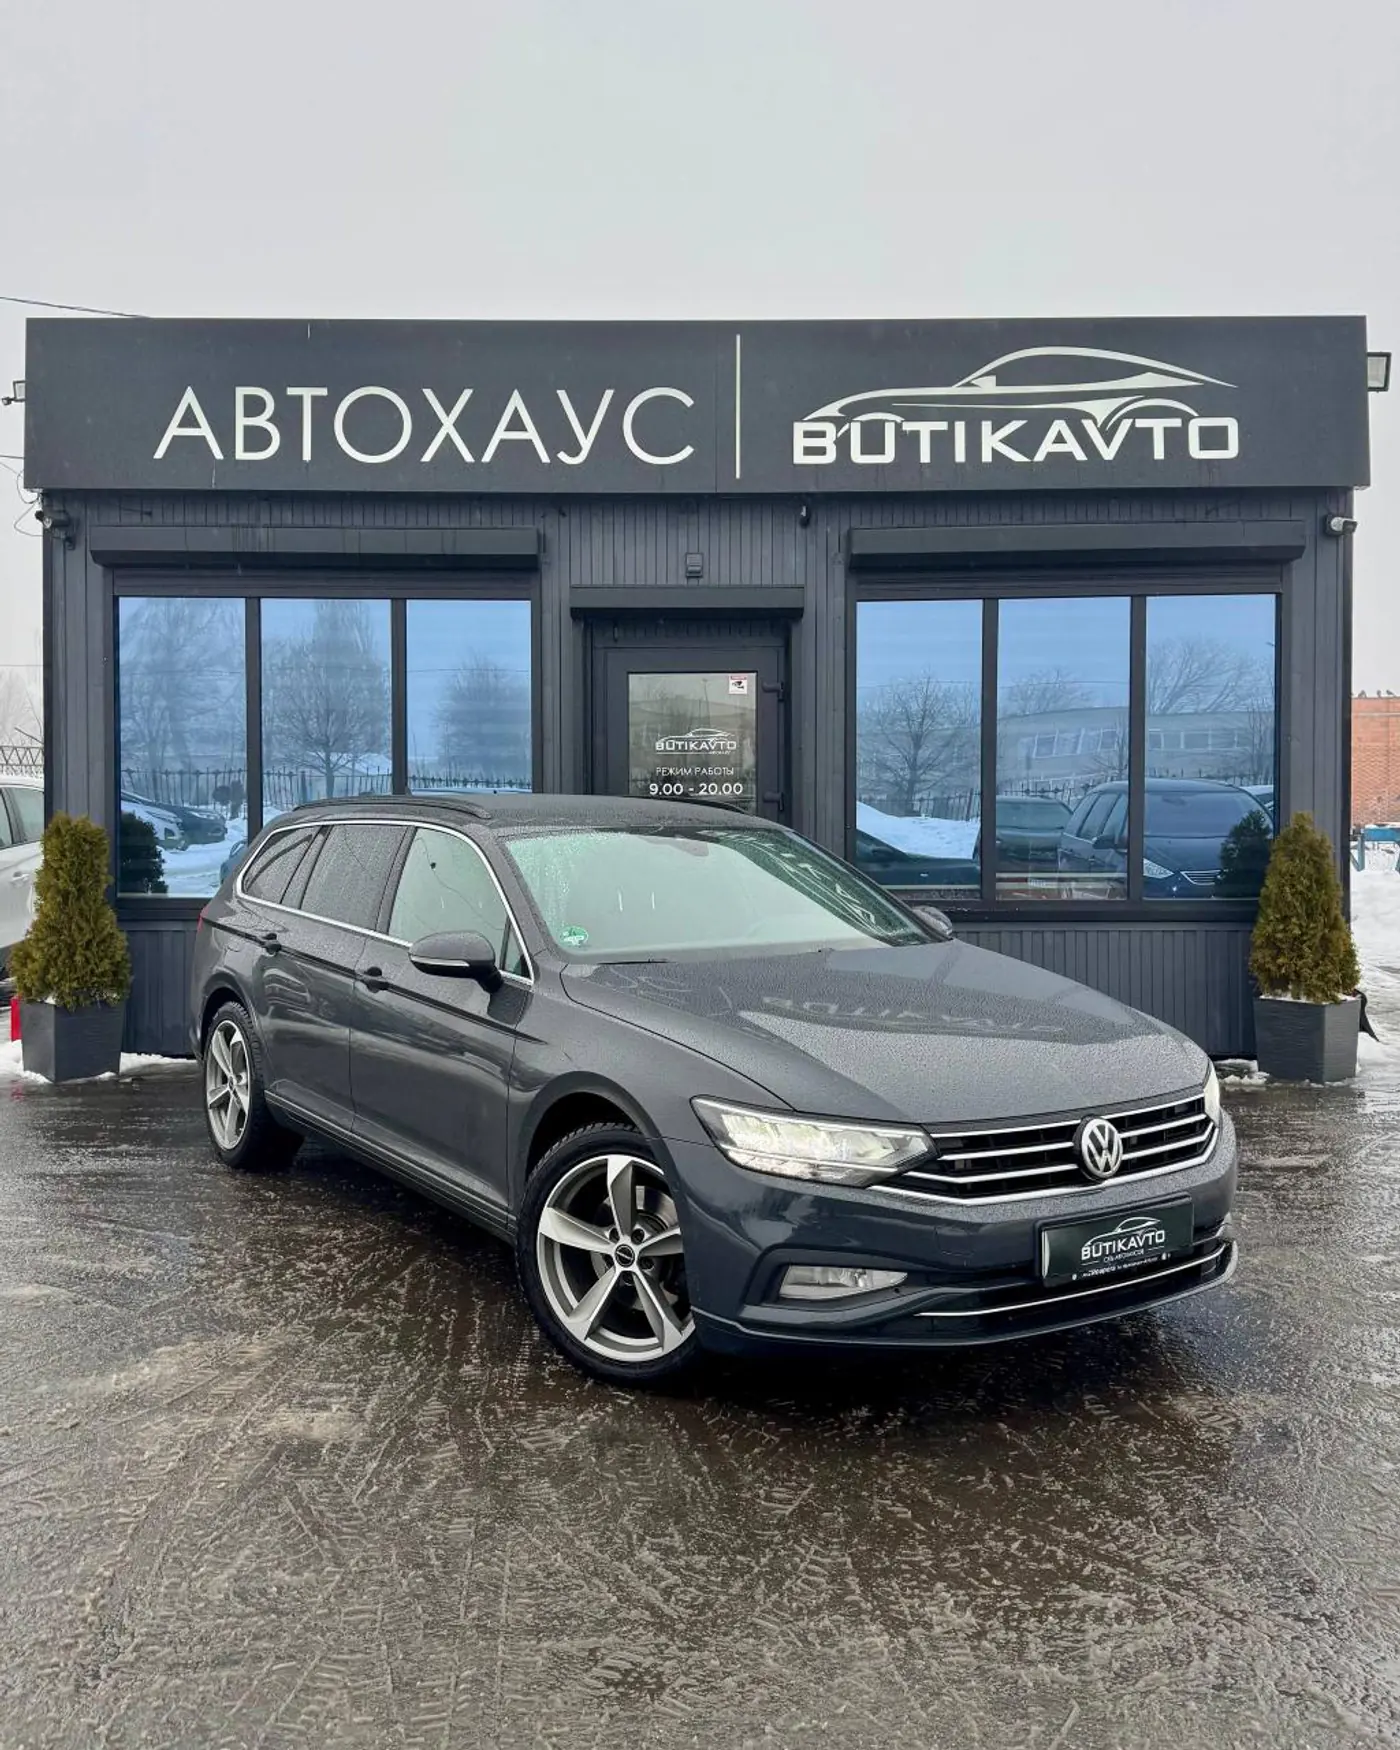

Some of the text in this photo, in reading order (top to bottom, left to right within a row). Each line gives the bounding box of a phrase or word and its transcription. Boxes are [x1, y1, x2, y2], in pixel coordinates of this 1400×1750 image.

[153, 385, 695, 465] АВТОХАУС
[793, 416, 1239, 465] BUTIKAVTO
[655, 740, 738, 751] BUTIKAVTO
[656, 767, 734, 777] РЕЖИМ РАБОТЫ
[649, 783, 684, 796] 9.00
[699, 783, 744, 796] 20.00
[1081, 1230, 1166, 1261] BUTIKAVTO
